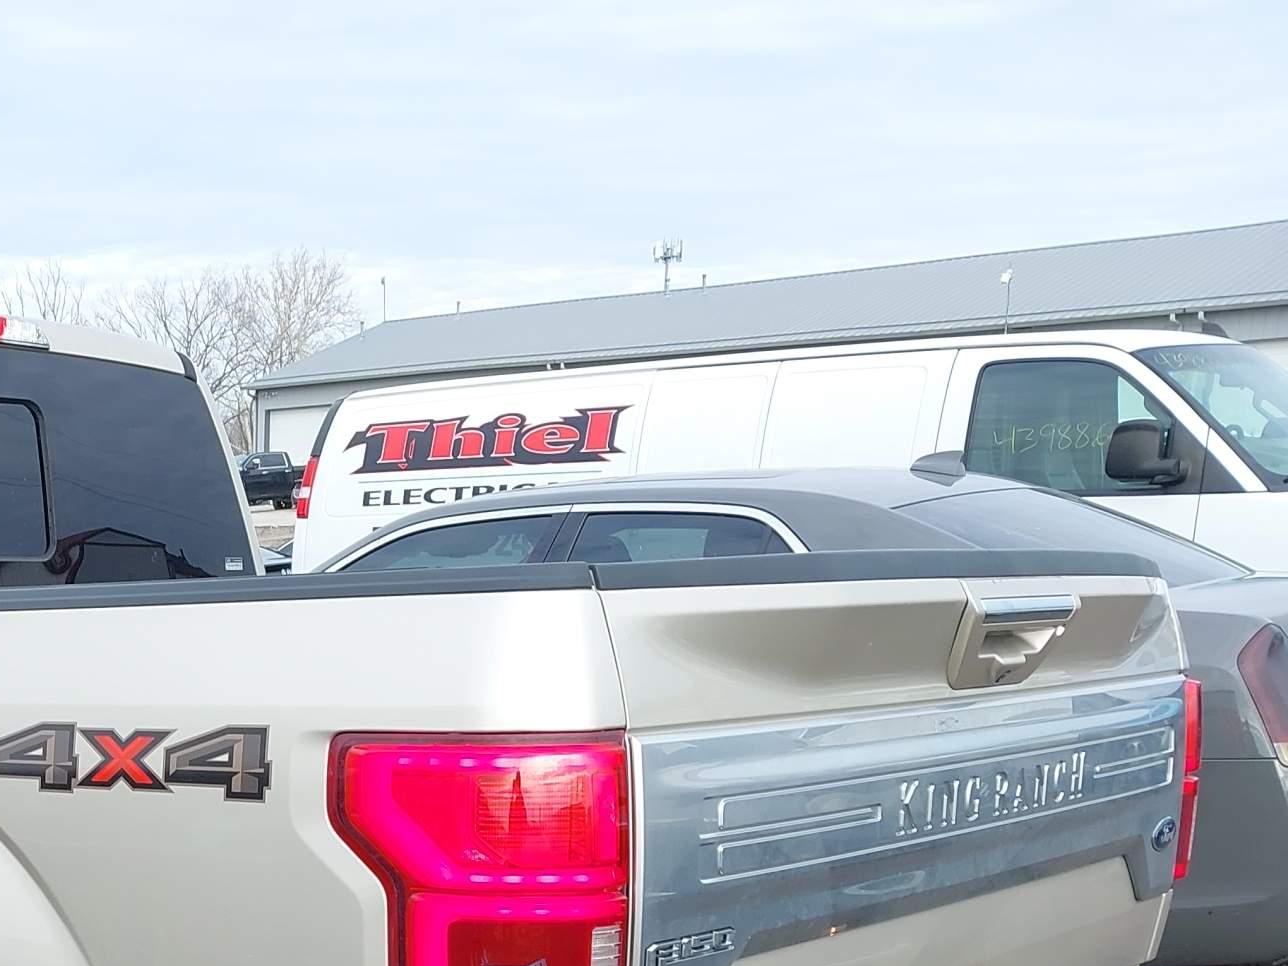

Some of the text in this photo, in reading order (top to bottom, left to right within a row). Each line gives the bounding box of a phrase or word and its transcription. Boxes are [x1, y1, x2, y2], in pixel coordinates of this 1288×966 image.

[365, 409, 618, 464] Thiel
[895, 751, 1087, 837] KING RANCH
